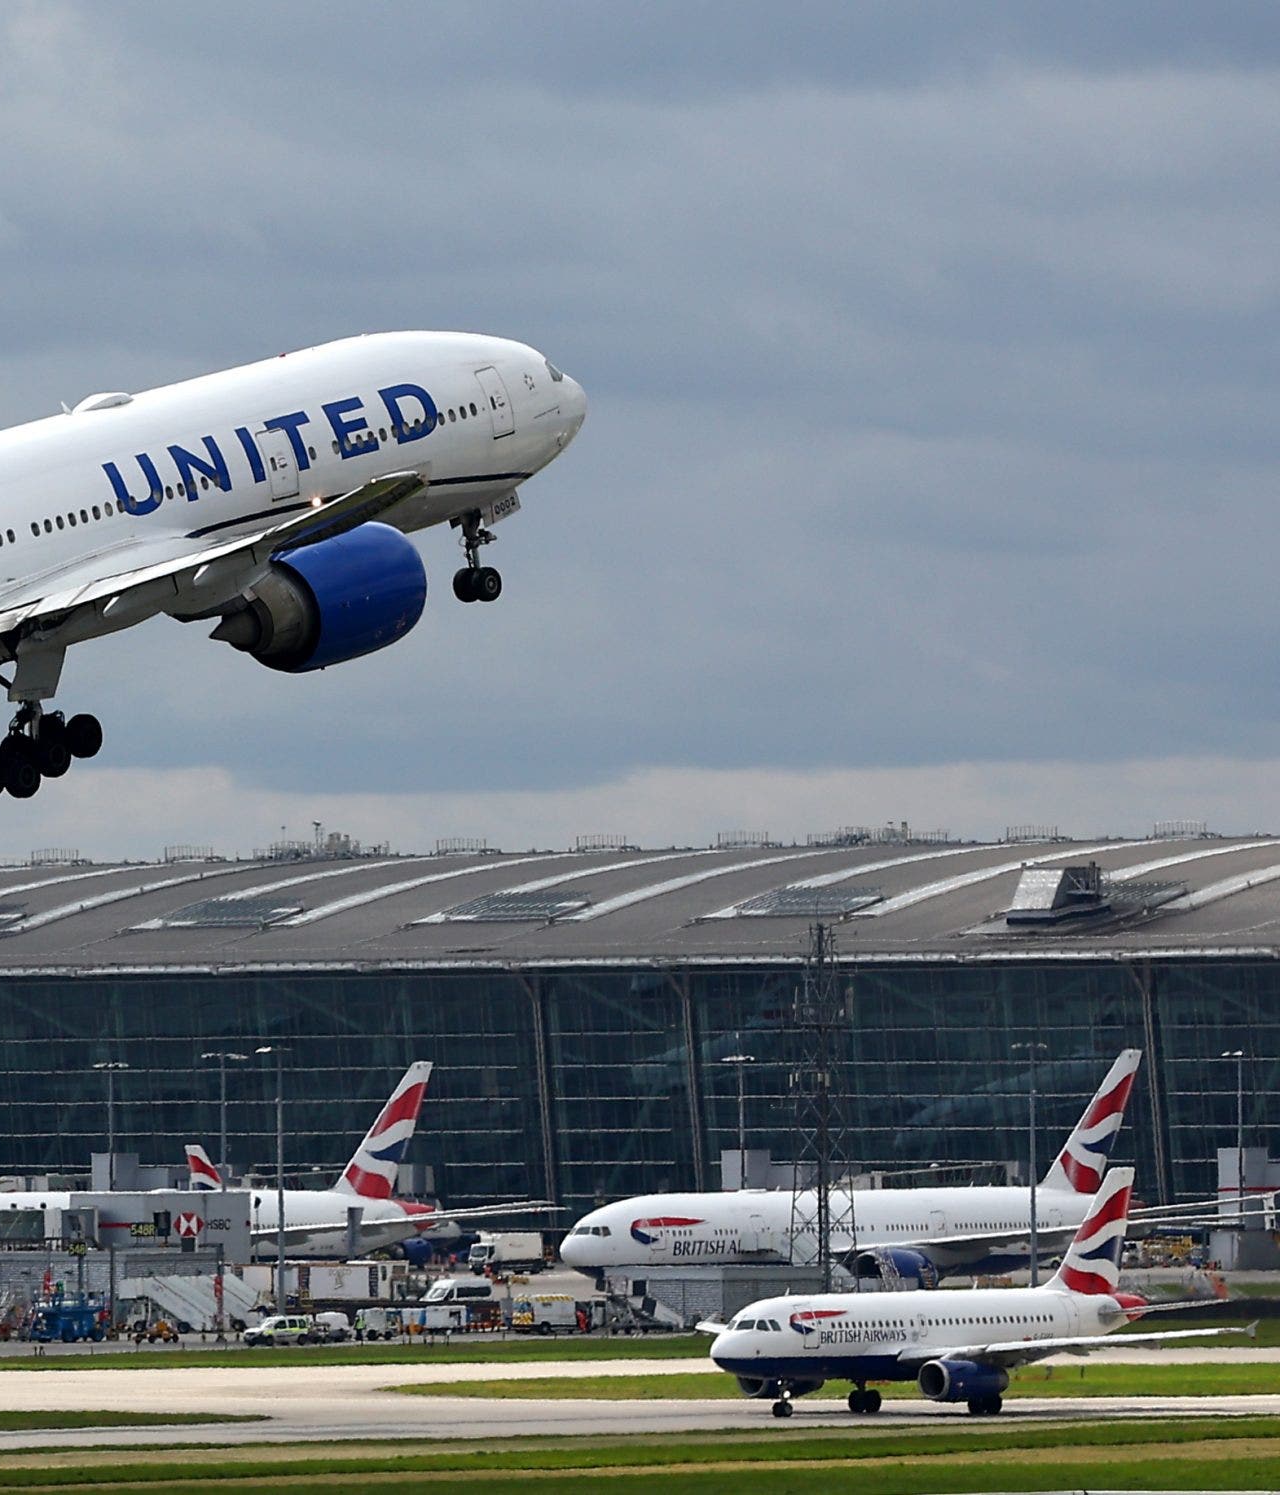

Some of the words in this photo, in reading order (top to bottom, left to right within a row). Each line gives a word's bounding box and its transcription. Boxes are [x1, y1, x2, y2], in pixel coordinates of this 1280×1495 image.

[102, 383, 438, 516] UNITED
[494, 496, 516, 515] 0002
[207, 1218, 231, 1231] HSBC
[673, 1240, 726, 1256] BRITISH
[820, 1329, 861, 1344] BRITISH
[862, 1328, 907, 1343] AIRWAYS
